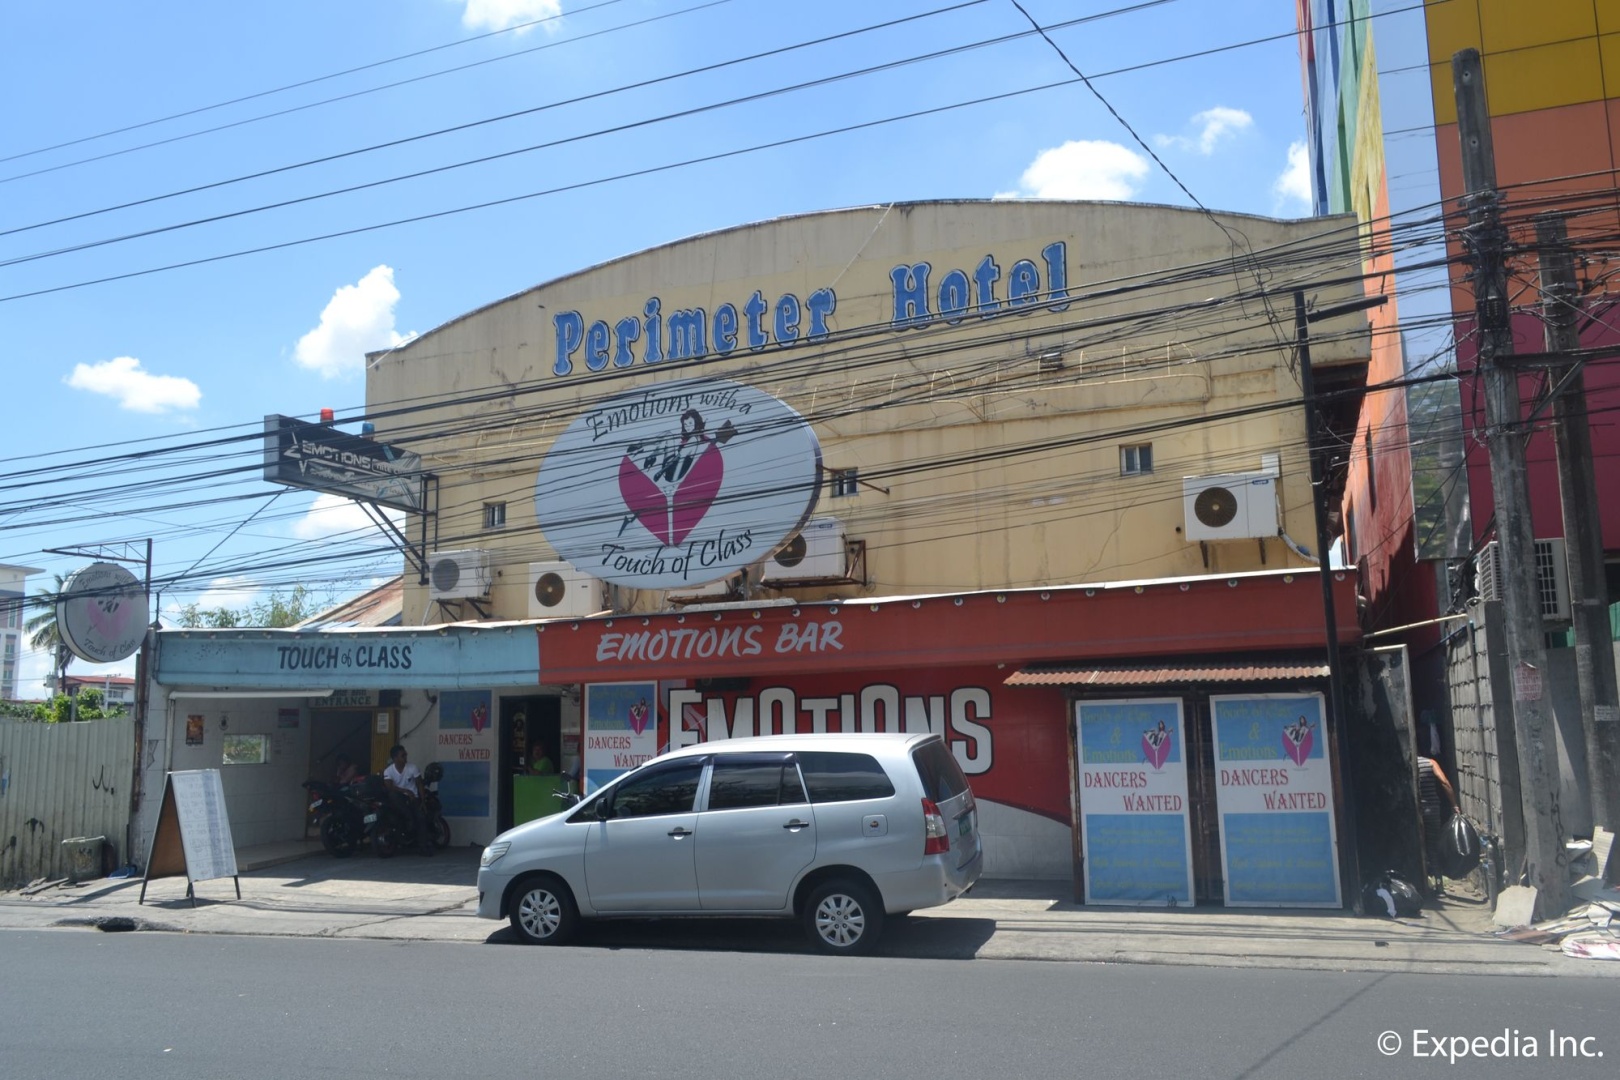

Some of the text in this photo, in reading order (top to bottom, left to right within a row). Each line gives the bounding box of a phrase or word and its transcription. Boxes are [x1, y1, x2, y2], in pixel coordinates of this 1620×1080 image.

[552, 240, 1071, 377] Perimeter Hotel
[585, 388, 752, 442] Emotions with a
[302, 440, 371, 468] EMOTIONS
[601, 528, 753, 581] Touch of Class
[83, 638, 106, 656] Touch
[108, 644, 118, 659] of
[596, 620, 845, 662] EMOTIONS BAR
[277, 645, 413, 670] TOUCH of CLASS
[314, 696, 372, 707] ENTRANCE
[438, 733, 473, 746] DANCERS
[588, 735, 632, 750] DANCERS
[458, 747, 491, 761] WANTED
[1220, 741, 1278, 760] Emotions
[1084, 770, 1148, 789] DANCERS
[1221, 767, 1290, 787] DANCERS
[1122, 792, 1183, 812] WANTED
[1262, 789, 1327, 810] WANTED
